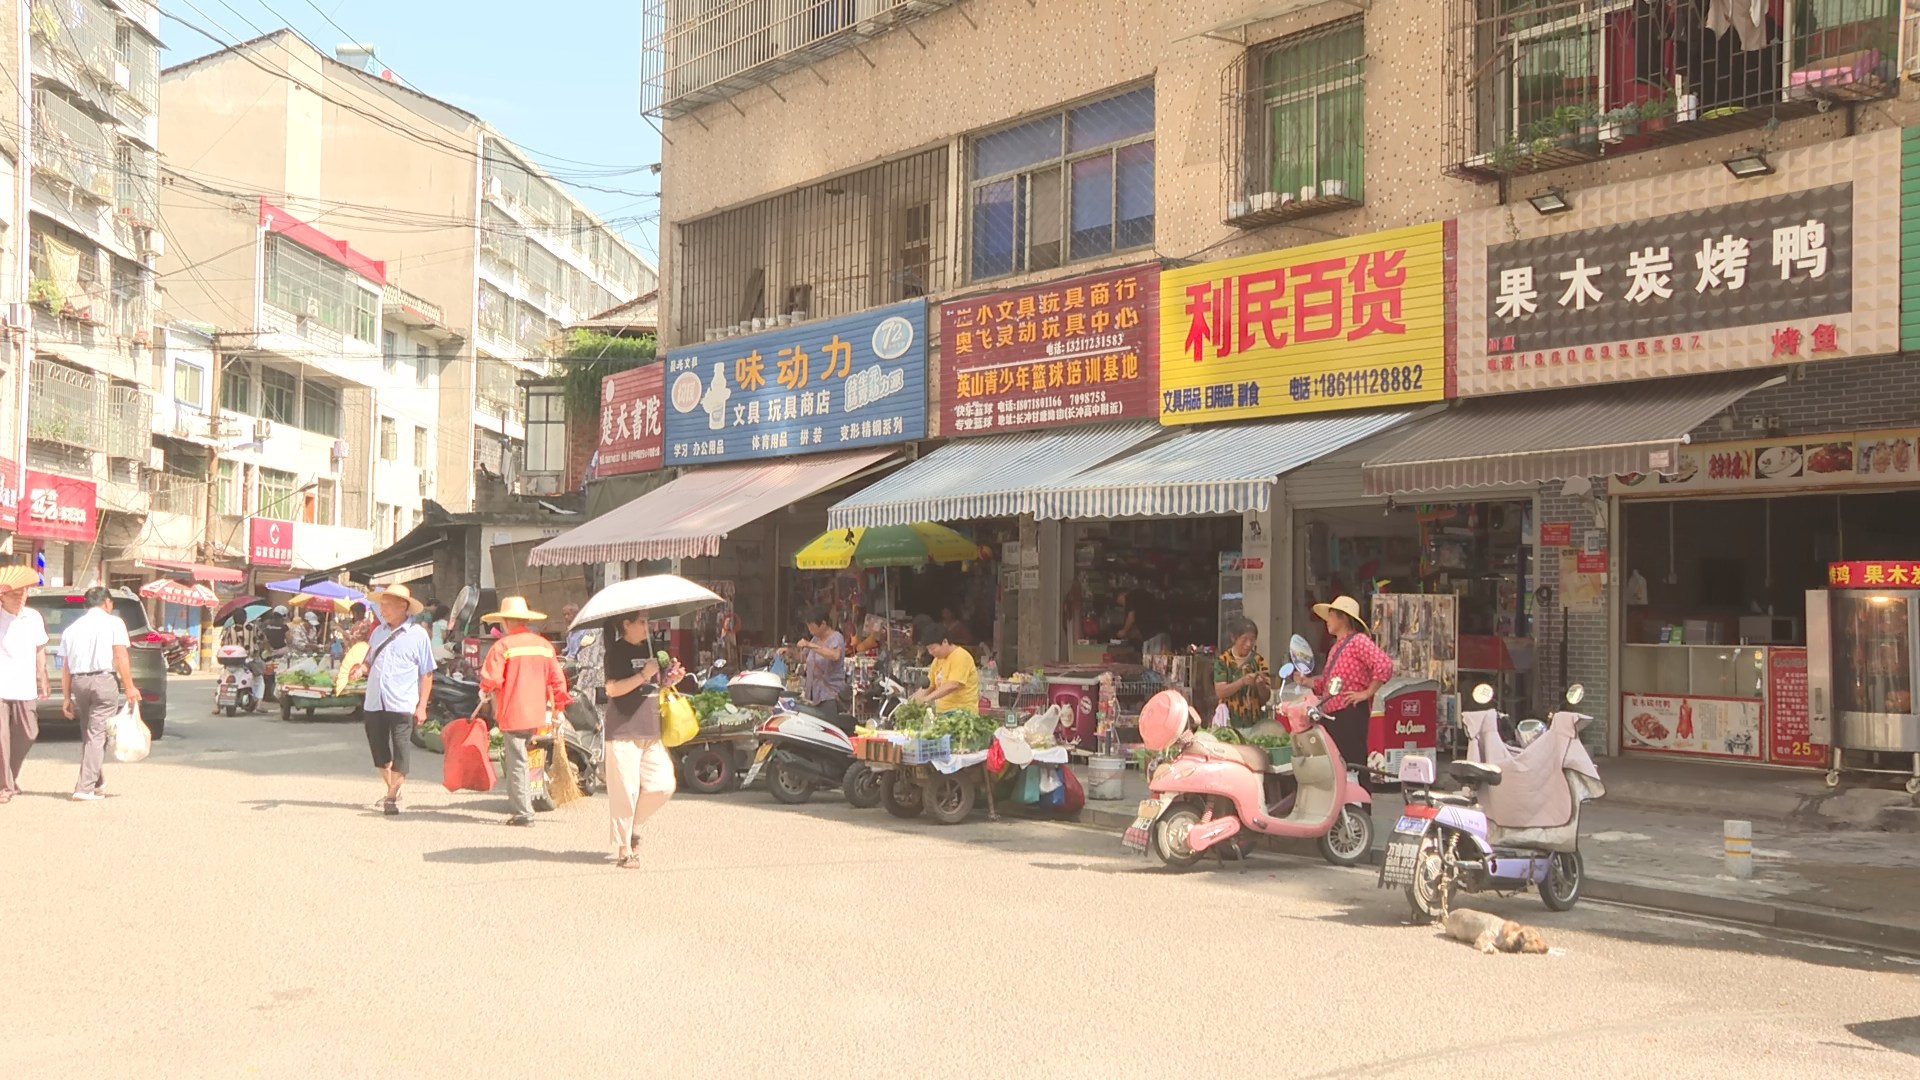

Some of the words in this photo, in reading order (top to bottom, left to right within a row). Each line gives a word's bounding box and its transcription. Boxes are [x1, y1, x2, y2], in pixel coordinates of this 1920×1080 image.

[1495, 219, 1828, 319] 果木炭烤鸭
[1185, 250, 1407, 362] 利民百货
[955, 307, 1139, 355] 奥飞灵动玩具中心
[1488, 336, 1515, 352] 加盟
[1771, 323, 1839, 357] 烤鱼
[735, 335, 852, 392] 味动力
[1488, 356, 1514, 371] 电话
[1519, 335, 1701, 368] 18606955597
[957, 353, 1139, 399] 英山青少年篮球培训基地
[1290, 364, 1424, 401] 电话:18611128882
[733, 401, 760, 427] 文具
[768, 390, 830, 422] 玩具商店
[1069, 391, 1107, 406] 7098758
[1163, 382, 1202, 414] 文具用品
[1205, 384, 1234, 410] 日用品
[1238, 381, 1260, 408] 副食
[674, 443, 689, 458] 学习
[693, 439, 724, 456] 办公用品
[752, 431, 788, 451] 体育用品
[800, 426, 823, 445] 拼装
[1792, 742, 1812, 756] 25
